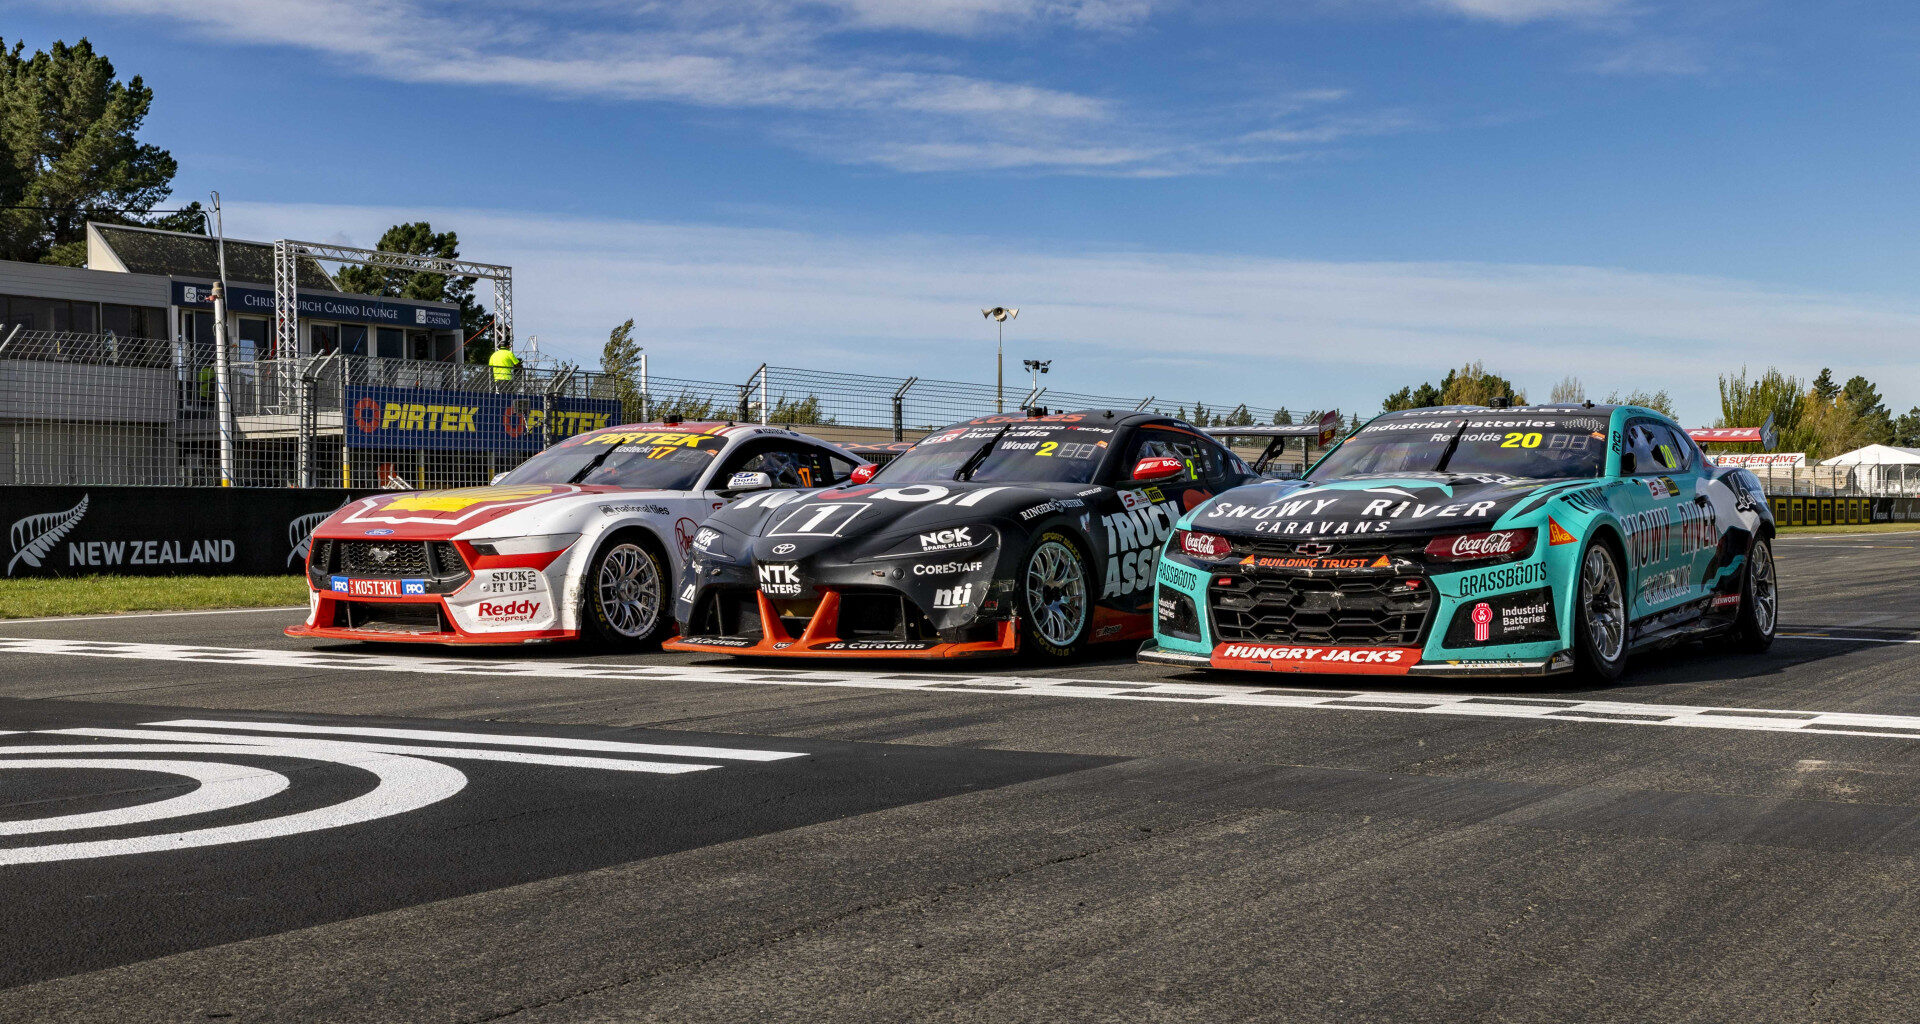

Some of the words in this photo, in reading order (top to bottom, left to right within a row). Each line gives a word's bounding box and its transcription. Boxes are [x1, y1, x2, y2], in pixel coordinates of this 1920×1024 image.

[244, 294, 322, 312] CHRISURCH
[325, 302, 359, 316] CASINO
[362, 306, 399, 319] LOUNGE
[426, 317, 450, 326] CASINO
[382, 403, 478, 432] PIRTEK
[528, 410, 610, 436] PRTEK
[1068, 426, 1114, 434] Racing
[1363, 420, 1450, 433] Industrial
[582, 432, 714, 448] PIRTEK
[960, 431, 1050, 440] Ausralia
[1430, 432, 1502, 442] Renolds
[1500, 432, 1542, 448] 20
[647, 446, 678, 460] 17
[1001, 442, 1038, 450] Wood
[1035, 442, 1058, 456] 2
[1660, 445, 1676, 468] 20
[1729, 456, 1797, 464] SUPERDRIVE
[798, 468, 812, 488] 17
[858, 468, 871, 476] BOC
[1186, 459, 1198, 480] 2
[614, 504, 651, 513] national
[650, 504, 670, 515] tiles
[1020, 502, 1055, 520] RINGERS
[1062, 499, 1084, 508] WESTERN
[1208, 498, 1340, 520] SNOWY
[1361, 500, 1496, 518] RIVER
[797, 505, 842, 533] 1
[1255, 521, 1391, 534] CARAVANS
[695, 528, 720, 546] NGK
[920, 526, 971, 546] NGK
[1550, 524, 1571, 543] Sika
[923, 544, 947, 552] SPARK
[948, 541, 972, 549] PLUGS
[1452, 532, 1514, 556] Coca-Cola
[69, 541, 125, 566] NEW
[130, 540, 235, 564] ZEALAND
[1258, 558, 1318, 568] BUILDING
[1322, 558, 1368, 568] TRUST
[492, 571, 527, 582] SUCK
[528, 571, 536, 590] LTD
[758, 564, 800, 584] NTK
[1100, 546, 1160, 600] ASSI
[1460, 562, 1546, 596] GRASSBOOTS
[492, 582, 505, 592] IT
[509, 582, 527, 592] UP
[761, 584, 801, 594] FILTERS
[934, 583, 972, 605] nti
[478, 600, 540, 618] Reddy
[1503, 615, 1545, 626] Batteries
[1504, 625, 1525, 633] Australia
[700, 638, 745, 646] Caravans
[848, 642, 925, 650] Caravans
[1224, 645, 1323, 660] HUNGRY
[1321, 650, 1403, 663] JACK'S
